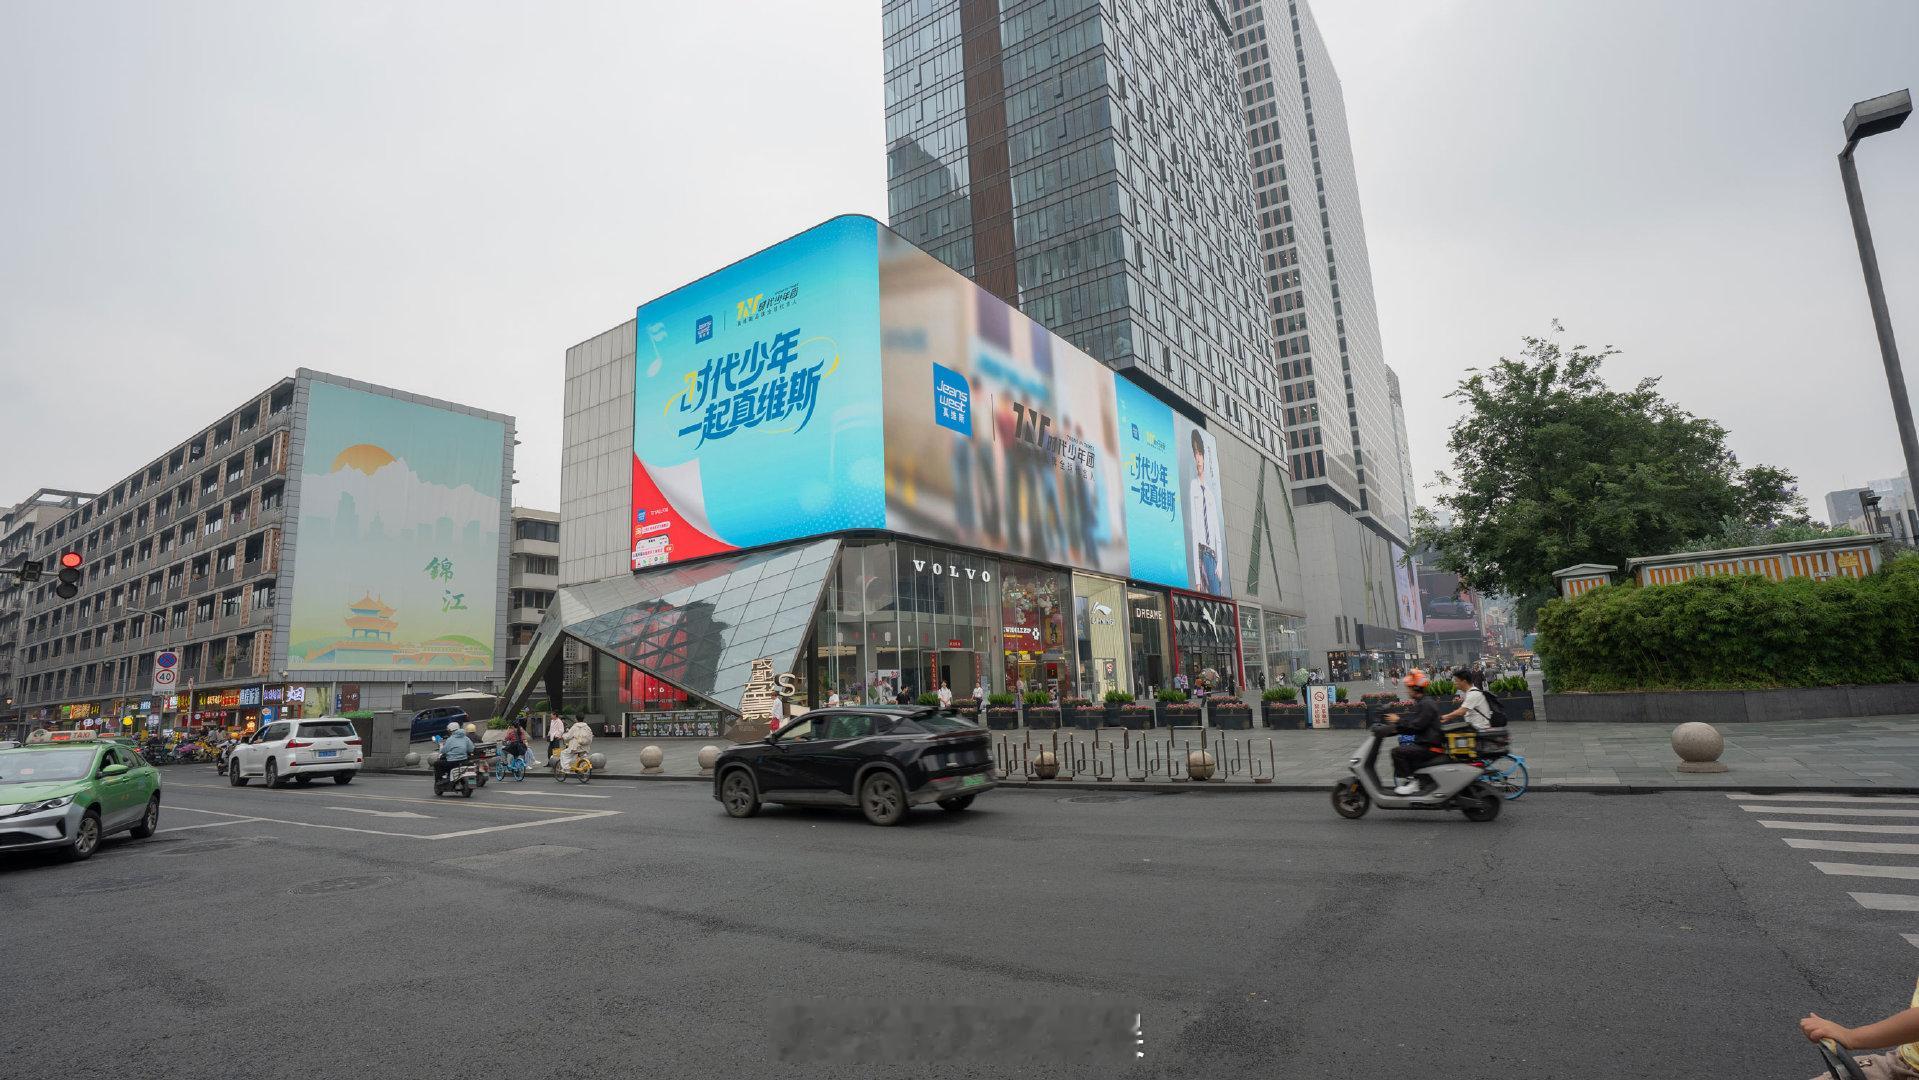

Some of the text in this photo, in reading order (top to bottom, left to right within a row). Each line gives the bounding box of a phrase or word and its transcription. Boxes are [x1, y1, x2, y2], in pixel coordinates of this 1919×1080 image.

[680, 328, 801, 413] 时代少年
[937, 380, 968, 402] Jeans
[678, 358, 825, 450] 一起真维斯
[939, 395, 966, 413] west
[943, 407, 965, 424] 真维斯
[1130, 453, 1168, 487] 时代少年
[1131, 481, 1176, 522] 一起真维斯
[913, 559, 991, 582] VOLVO
[1136, 608, 1163, 620] DREAME
[285, 685, 306, 703] 烟
